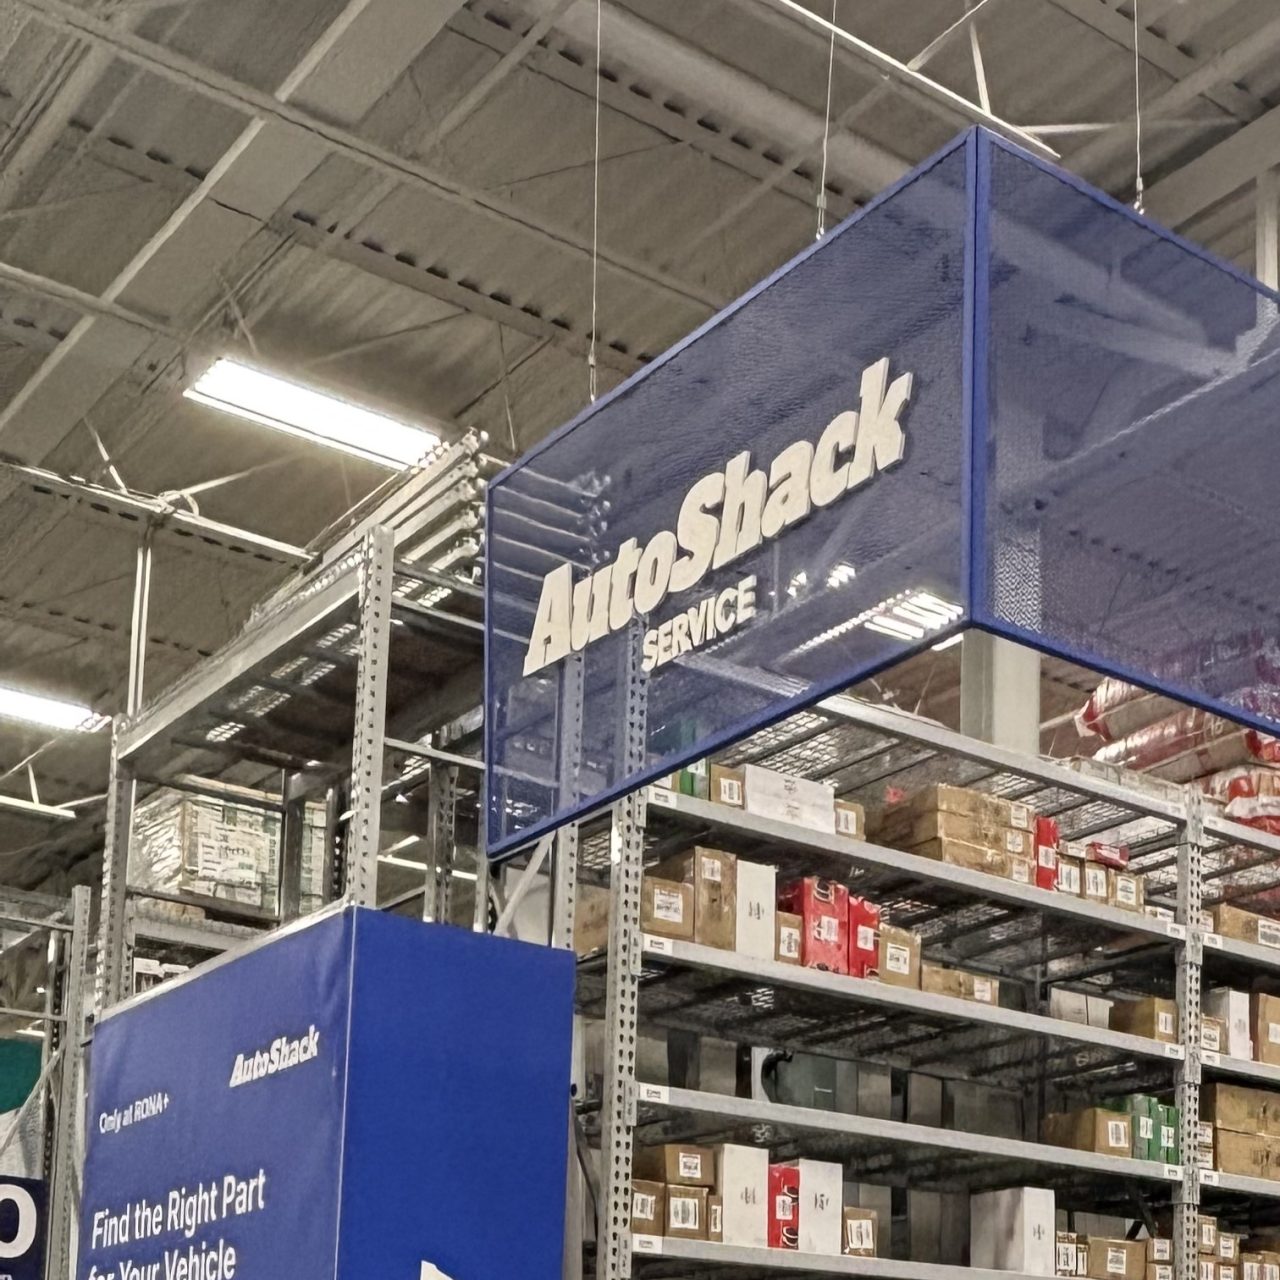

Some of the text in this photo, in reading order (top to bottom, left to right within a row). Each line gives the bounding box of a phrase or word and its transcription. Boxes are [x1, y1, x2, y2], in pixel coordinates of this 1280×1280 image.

[522, 357, 913, 677] AutoShack
[641, 574, 757, 673] SERVICE
[229, 1024, 320, 1088] AutoShack
[92, 1168, 266, 1250] Find the Right Part
